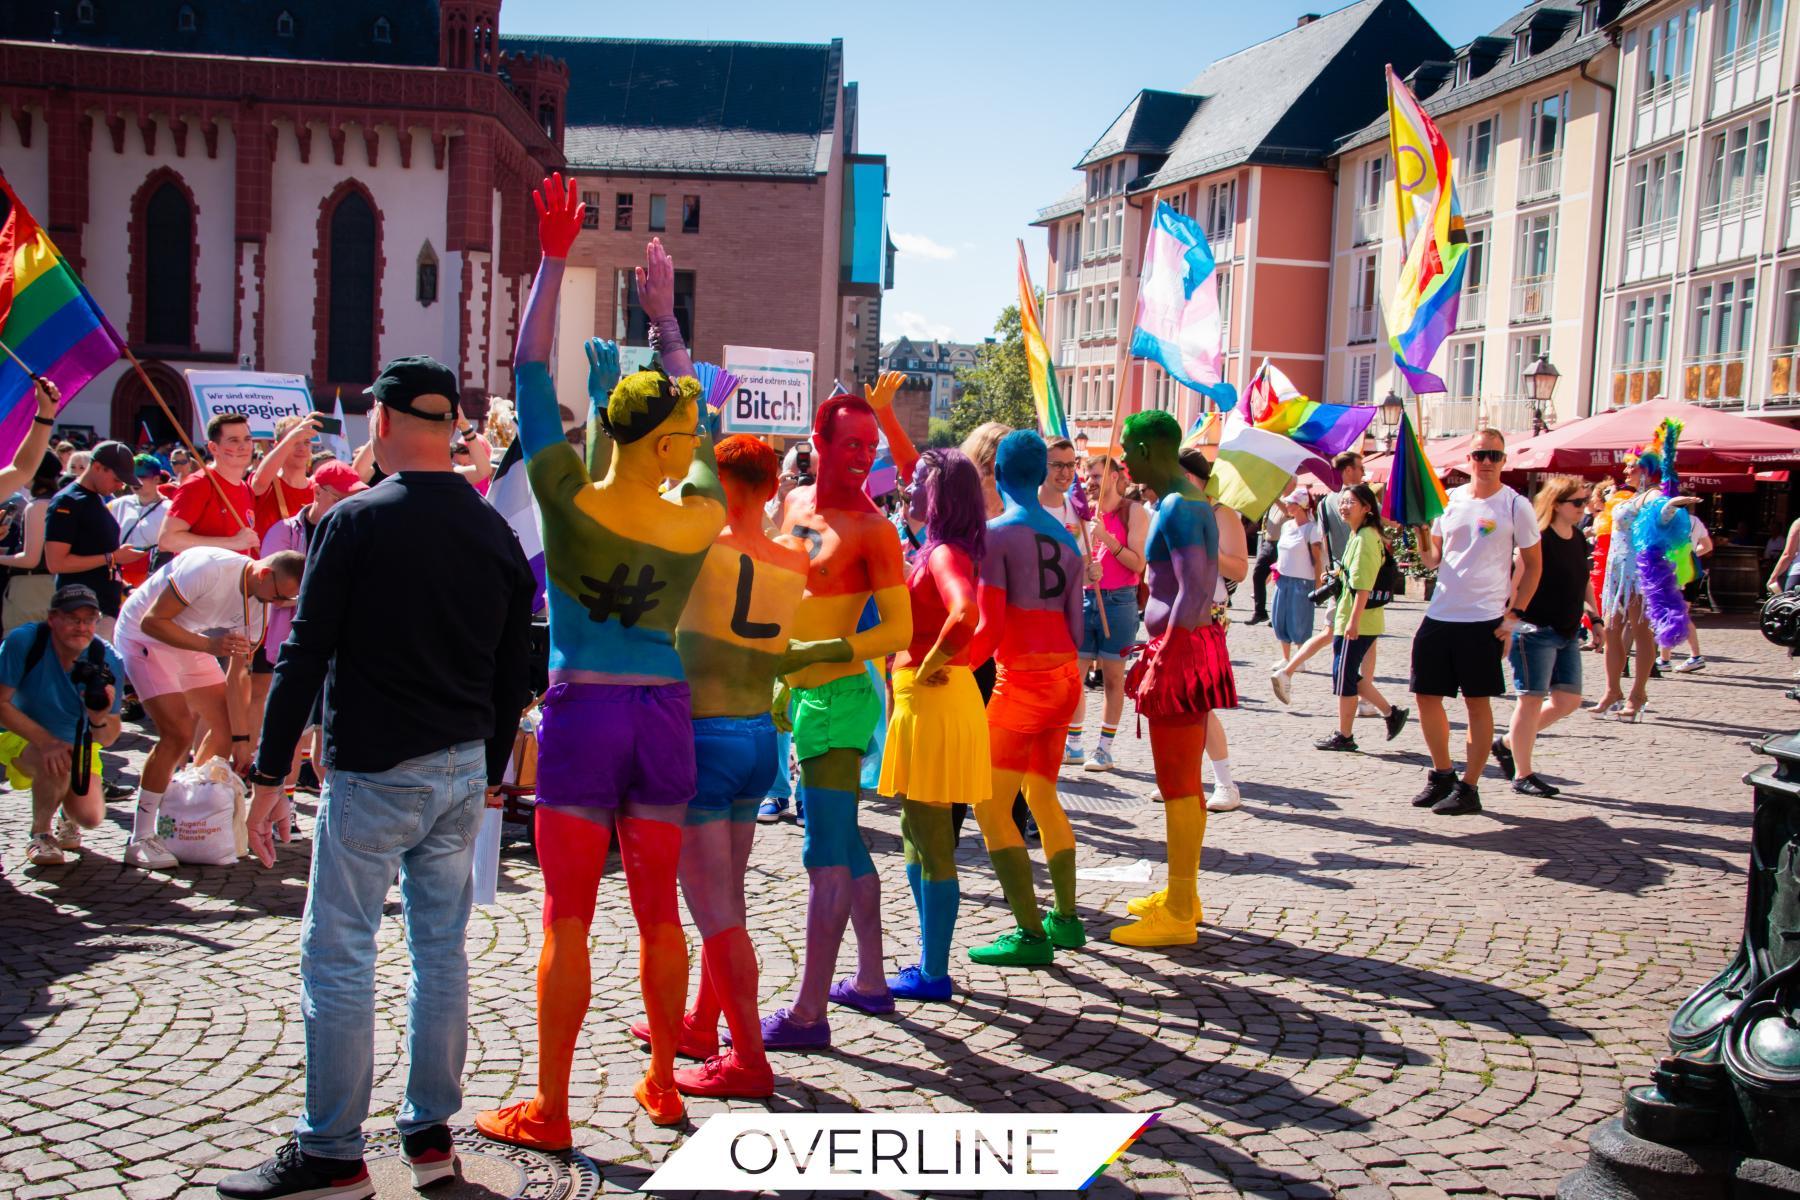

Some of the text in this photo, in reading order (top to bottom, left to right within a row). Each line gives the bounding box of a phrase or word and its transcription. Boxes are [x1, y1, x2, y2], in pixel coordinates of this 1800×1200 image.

[207, 392, 224, 400] Wir
[245, 393, 274, 401] extrem
[750, 376, 764, 384] sind
[764, 377, 787, 386] extrem
[787, 378, 801, 387] stolz
[736, 388, 801, 421] Bitch!
[1035, 534, 1066, 599] B
[579, 562, 667, 629] #
[730, 553, 781, 639] L
[180, 820, 207, 829] Jugend
